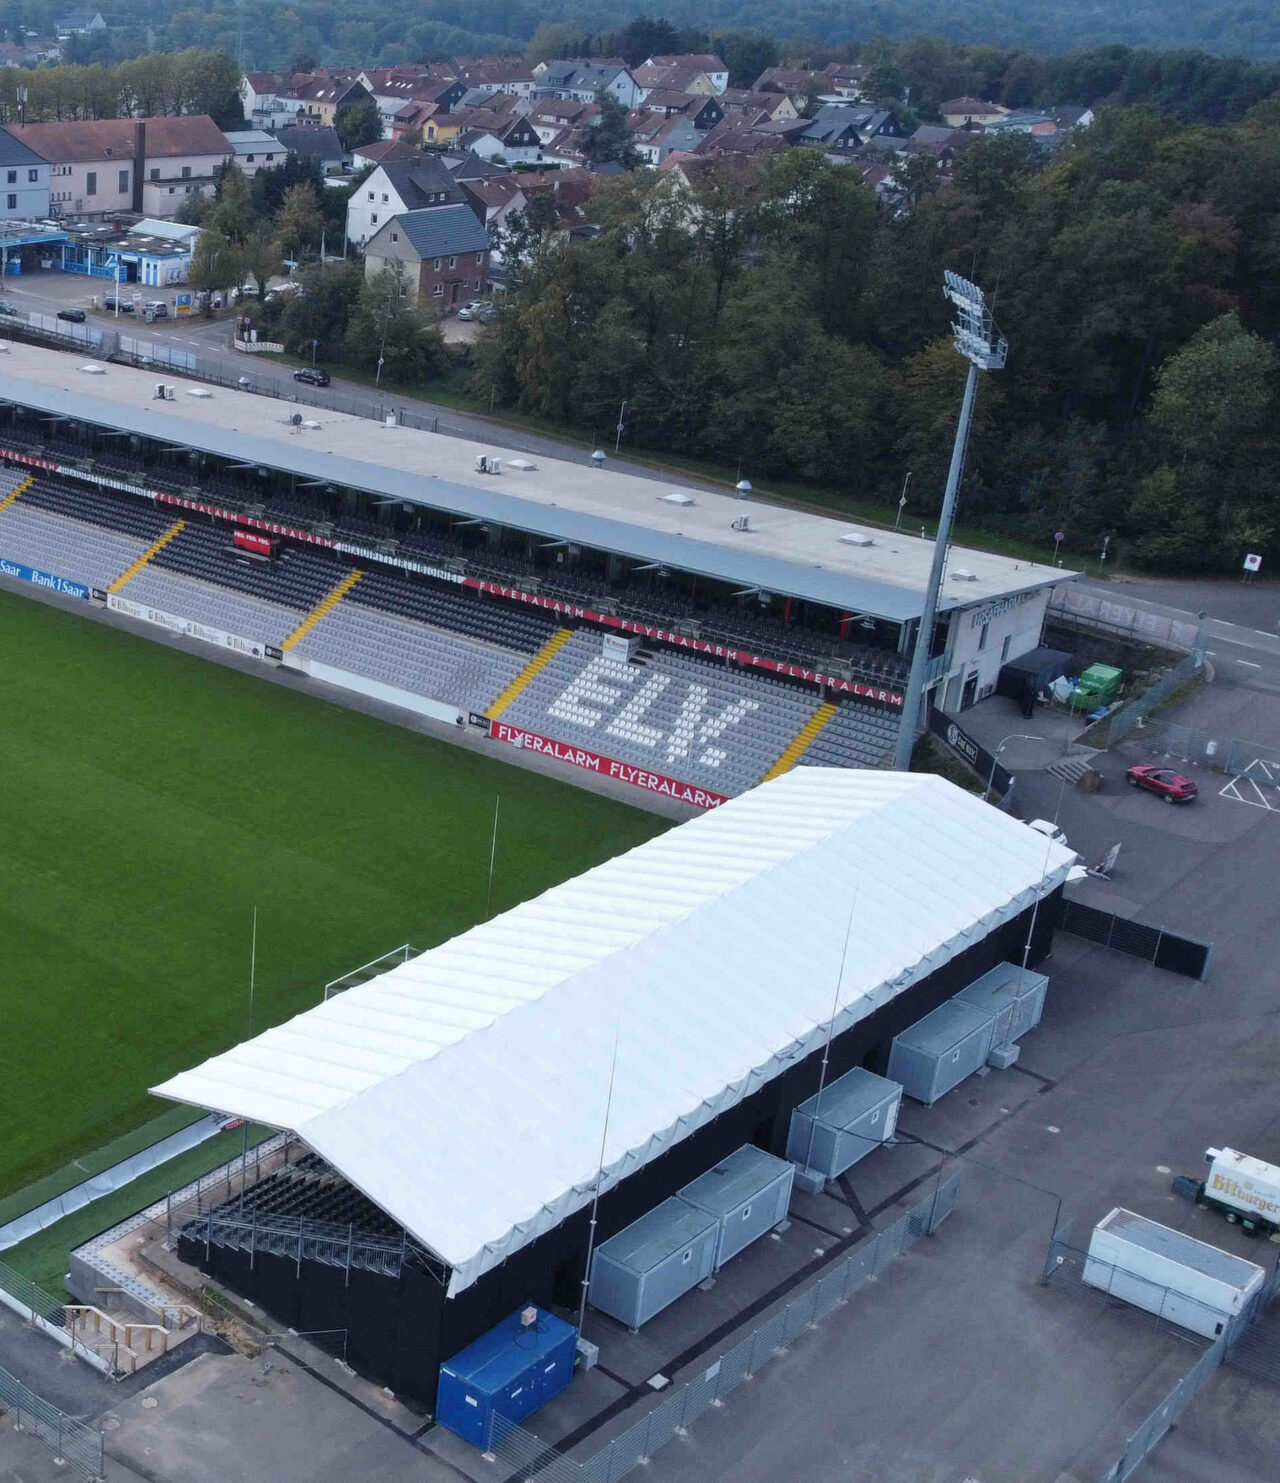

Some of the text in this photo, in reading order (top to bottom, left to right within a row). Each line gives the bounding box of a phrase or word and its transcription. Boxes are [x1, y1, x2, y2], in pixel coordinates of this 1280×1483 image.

[31, 570, 84, 599] Bank1Saar
[159, 493, 238, 522] FLYERALARM
[247, 518, 332, 548] FLYERALARM
[479, 581, 584, 618] FLYERALARM
[621, 620, 737, 660] FLYERALARM
[776, 663, 902, 706] FLYERALARM
[498, 724, 721, 808] FLYERALARM FLYERALARM
[1213, 1173, 1278, 1214] Bitburger
